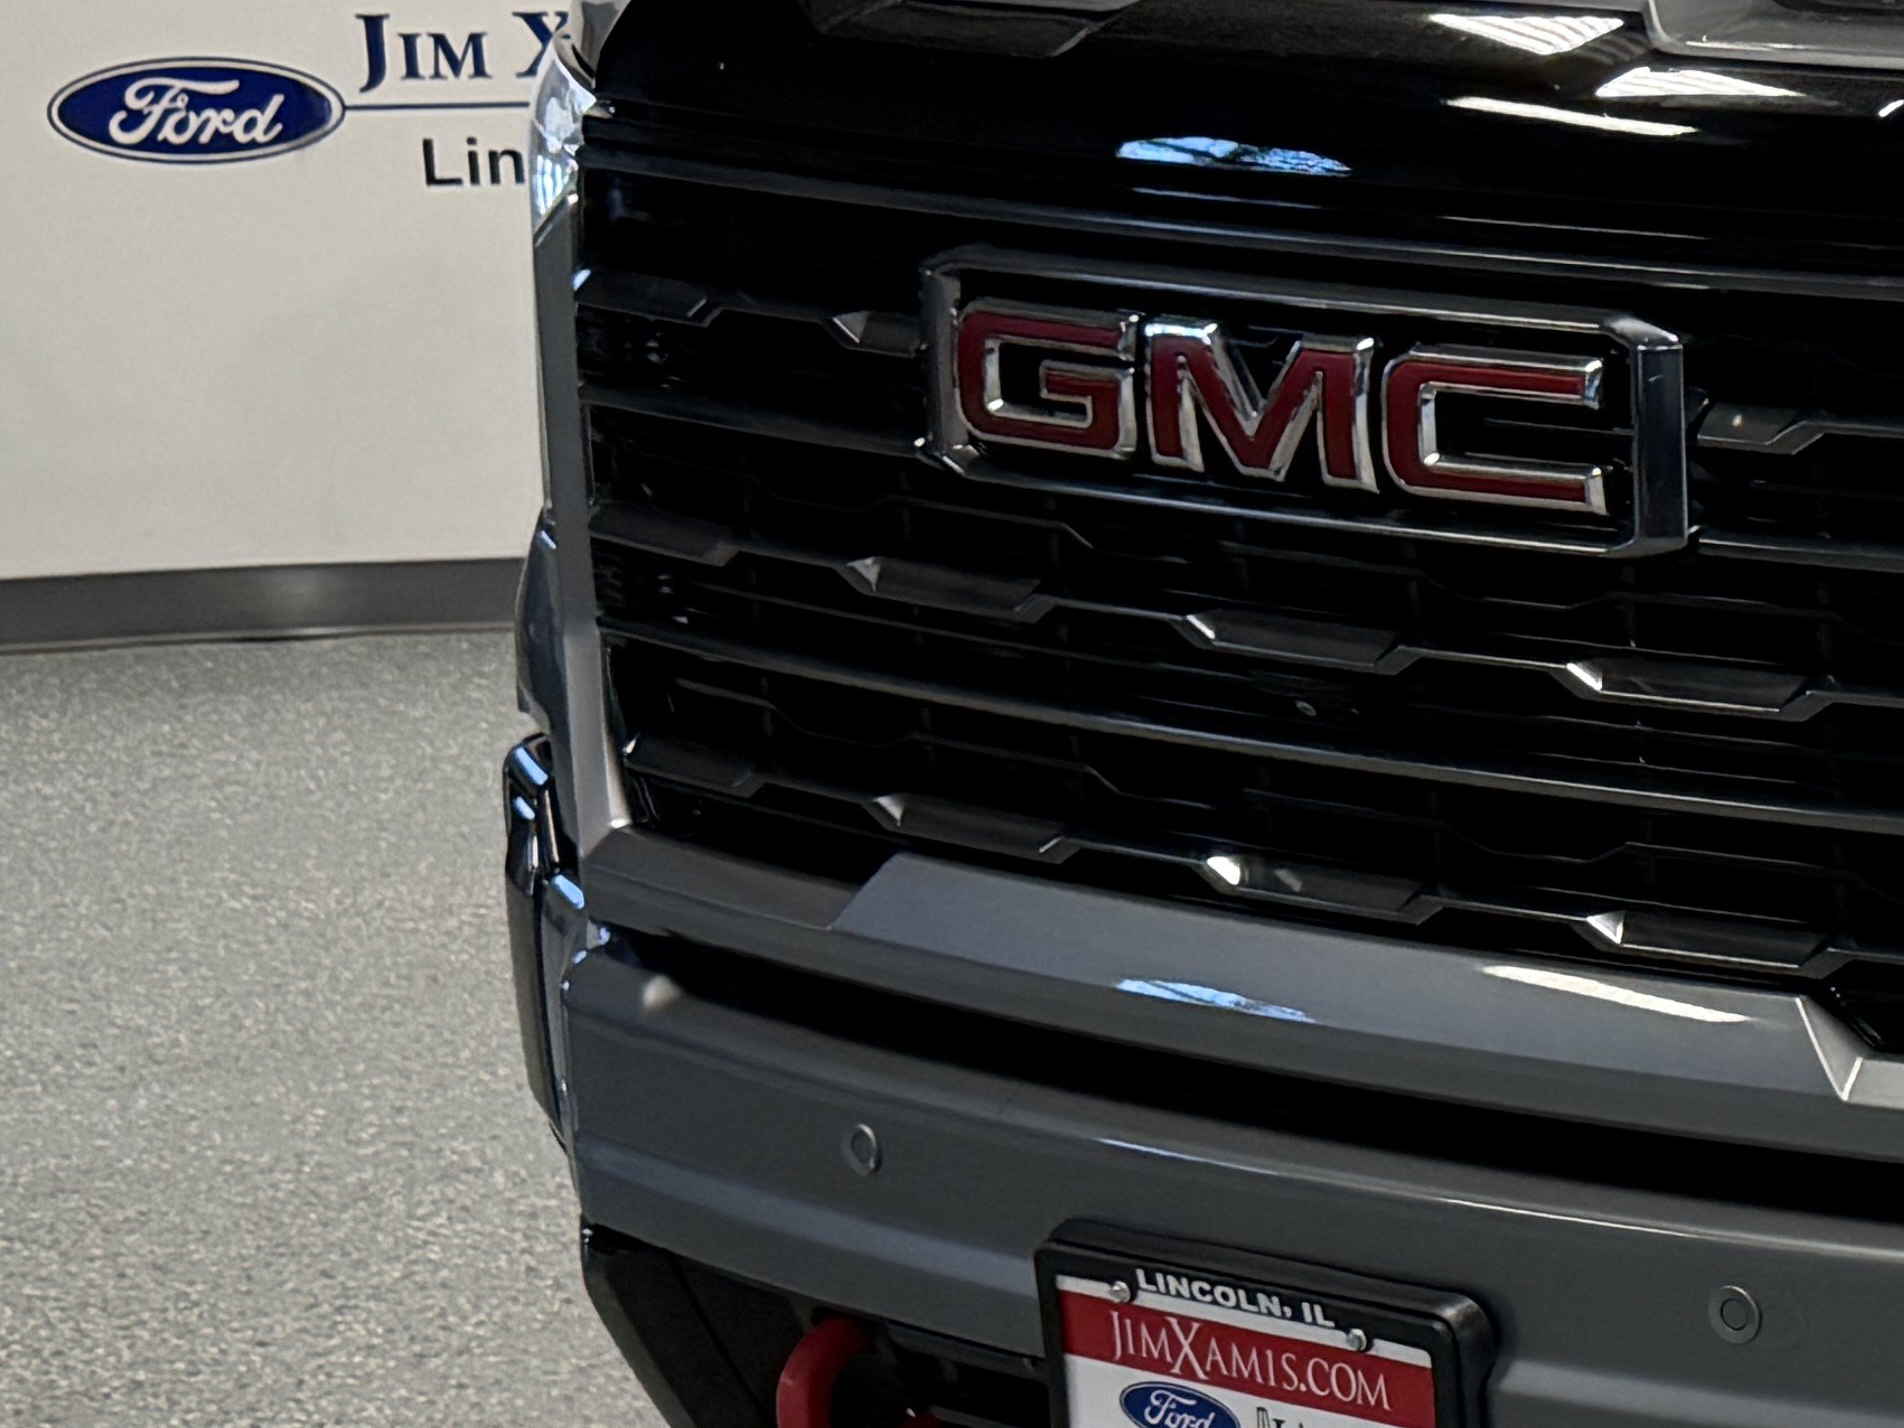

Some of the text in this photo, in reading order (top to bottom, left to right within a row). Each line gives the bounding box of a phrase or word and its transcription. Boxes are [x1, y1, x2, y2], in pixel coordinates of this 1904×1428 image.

[355, 13, 492, 93] JIM
[108, 77, 285, 145] Ford
[421, 137, 526, 186] Lin
[954, 296, 1609, 516] GMC
[1135, 1268, 1336, 1328] LINCOLN, IL
